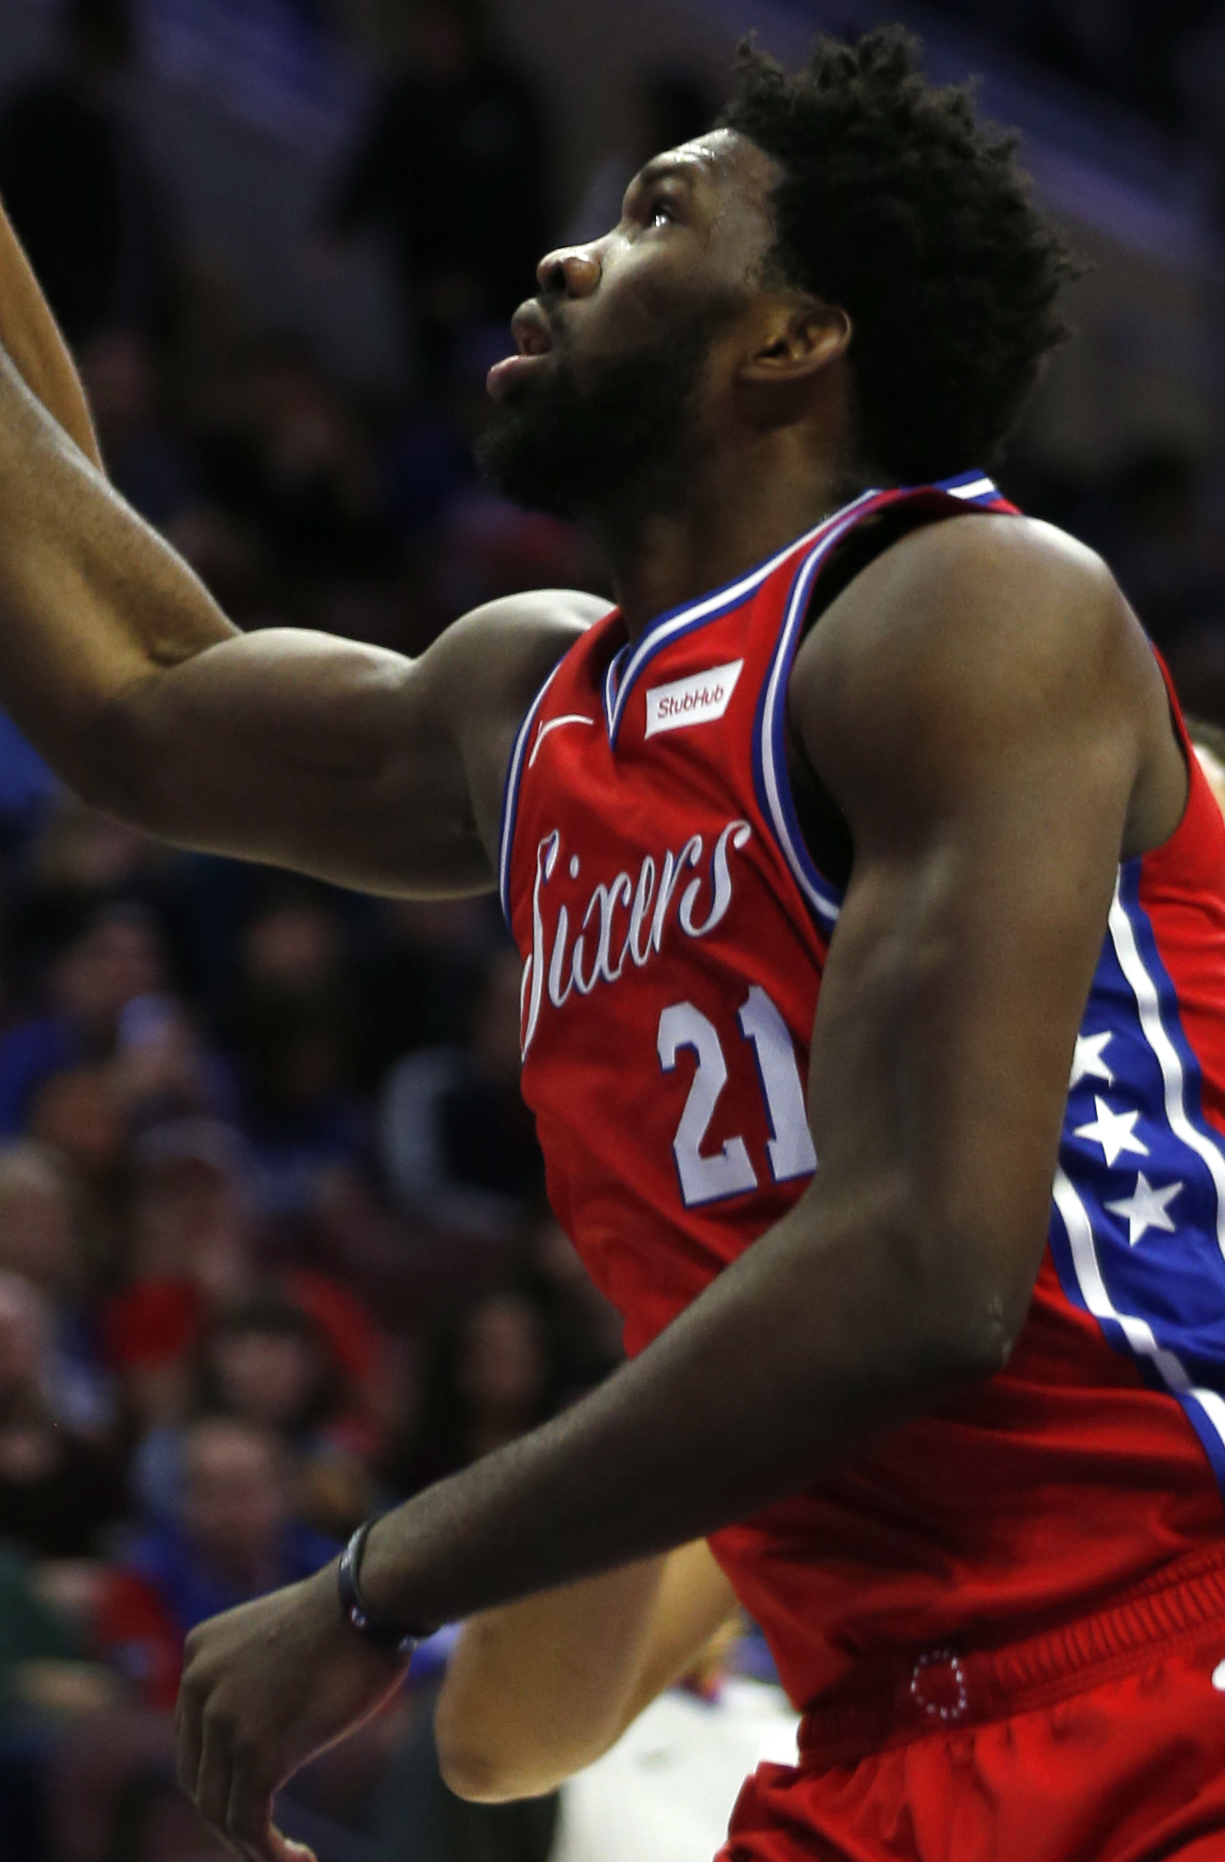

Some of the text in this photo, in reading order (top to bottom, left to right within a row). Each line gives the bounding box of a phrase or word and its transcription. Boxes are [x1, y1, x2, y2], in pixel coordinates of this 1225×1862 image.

[657, 683, 724, 719] StubHub
[521, 819, 752, 1064] Sixers
[656, 984, 819, 1210] 21
